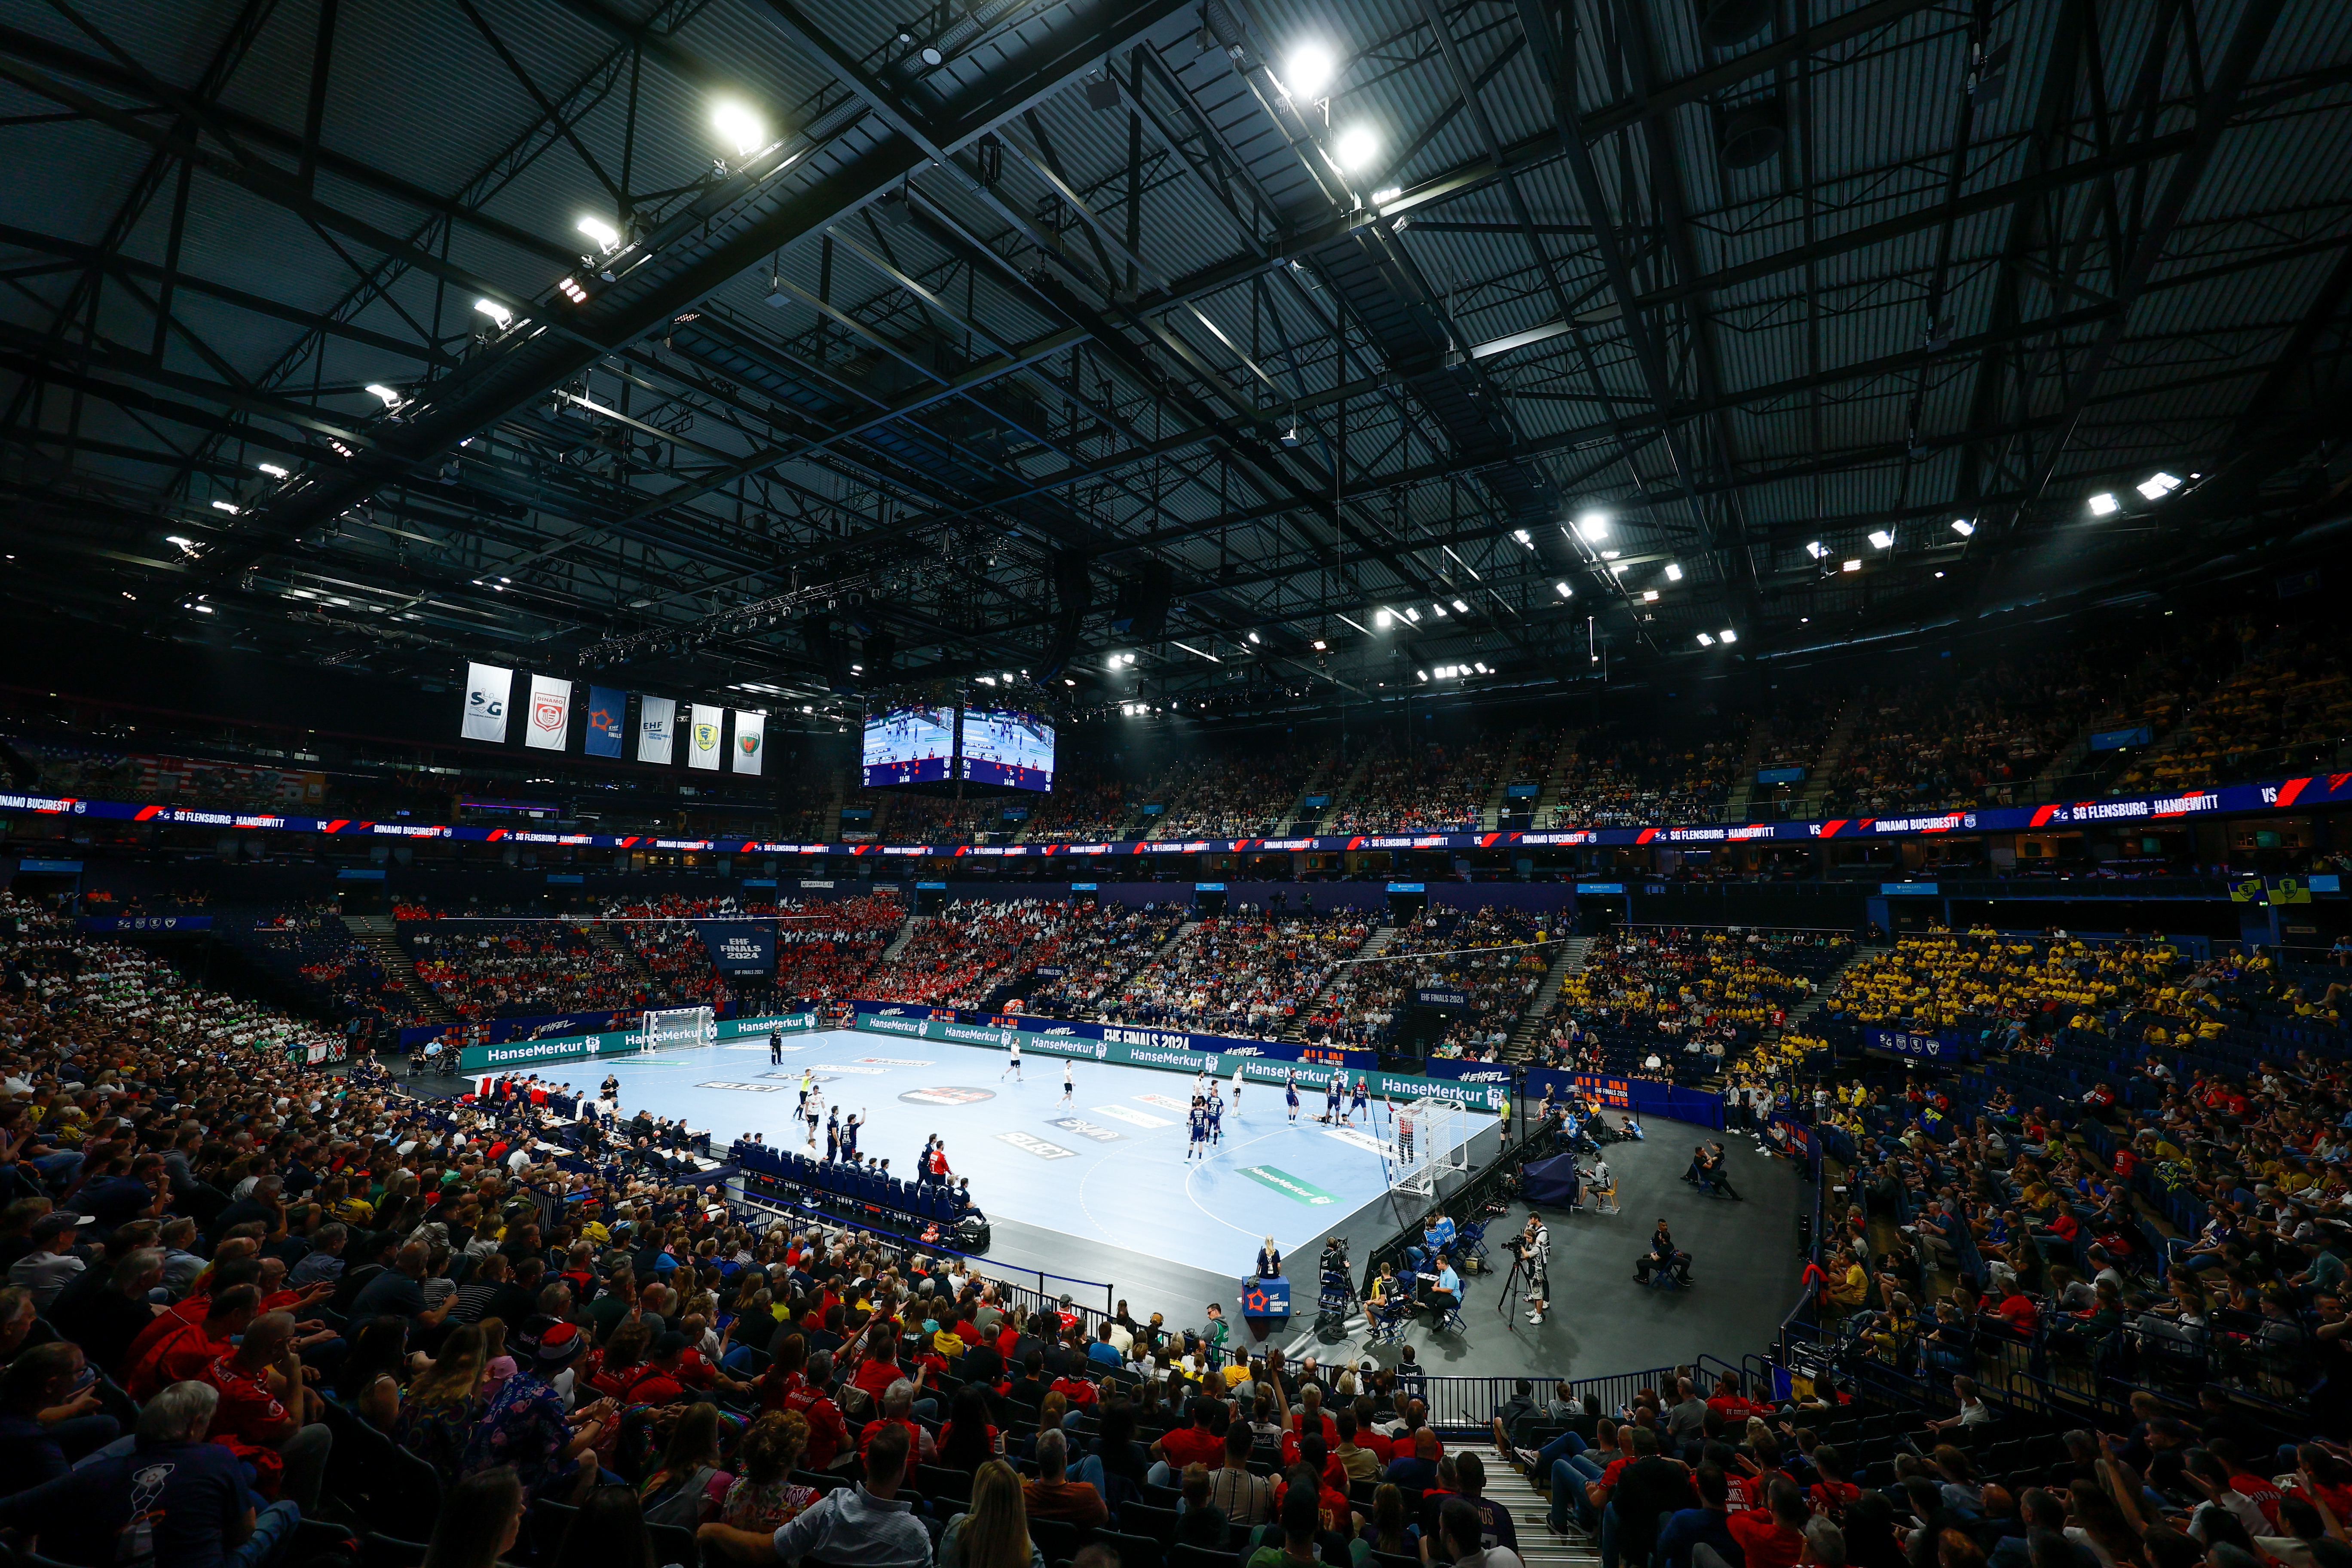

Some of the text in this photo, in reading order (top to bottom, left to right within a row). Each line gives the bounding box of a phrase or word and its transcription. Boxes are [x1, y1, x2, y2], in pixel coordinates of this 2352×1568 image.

[943, 770, 950, 778] 20
[964, 770, 970, 779] 27
[1004, 778, 1015, 786] 14:58
[2261, 787, 2278, 803] VS
[26, 797, 70, 812] BUCURESTI
[174, 811, 185, 821] SG
[2073, 806, 2087, 820] SG
[317, 821, 327, 830] VS
[1809, 824, 1821, 835] VS
[1875, 816, 1959, 832] DINAMO BUCURESTI
[374, 824, 440, 836] DINAMO BUCURESTI
[1670, 830, 1681, 840] SG
[515, 833, 524, 841] SG
[1473, 836, 1482, 845] VS
[1522, 833, 1584, 844] DINAMO BUCURESTI
[656, 840, 677, 848] DINAMO
[1264, 840, 1310, 849] DINAMO BUCURESTI
[1371, 839, 1379, 847] SG
[1421, 993, 1464, 1004] EHF FINALS 2024
[738, 1017, 802, 1033] HanseMerkur
[870, 1018, 918, 1032] HanseMerkur
[625, 1029, 703, 1045] HanseMerkur
[945, 1024, 1000, 1042] HanseMerkur
[1031, 1036, 1094, 1054] HanseMerkur
[1104, 1029, 1190, 1050] EHF FINALS 2024
[488, 1042, 582, 1061] HanseMerkur
[1130, 1046, 1203, 1067] HanseMerkur
[1246, 1062, 1331, 1083] HanseMerkur
[698, 1081, 784, 1092] SELECT
[1380, 1075, 1485, 1105] HanseMerkur
[1210, 1104, 1217, 1112] 24
[1196, 1117, 1202, 1125] 31
[995, 1132, 1075, 1158] SELECT
[2117, 1155, 2123, 1164] 10
[1247, 1166, 1315, 1197] HanseMerkur
[1252, 1435, 1271, 1444] Danfoss
